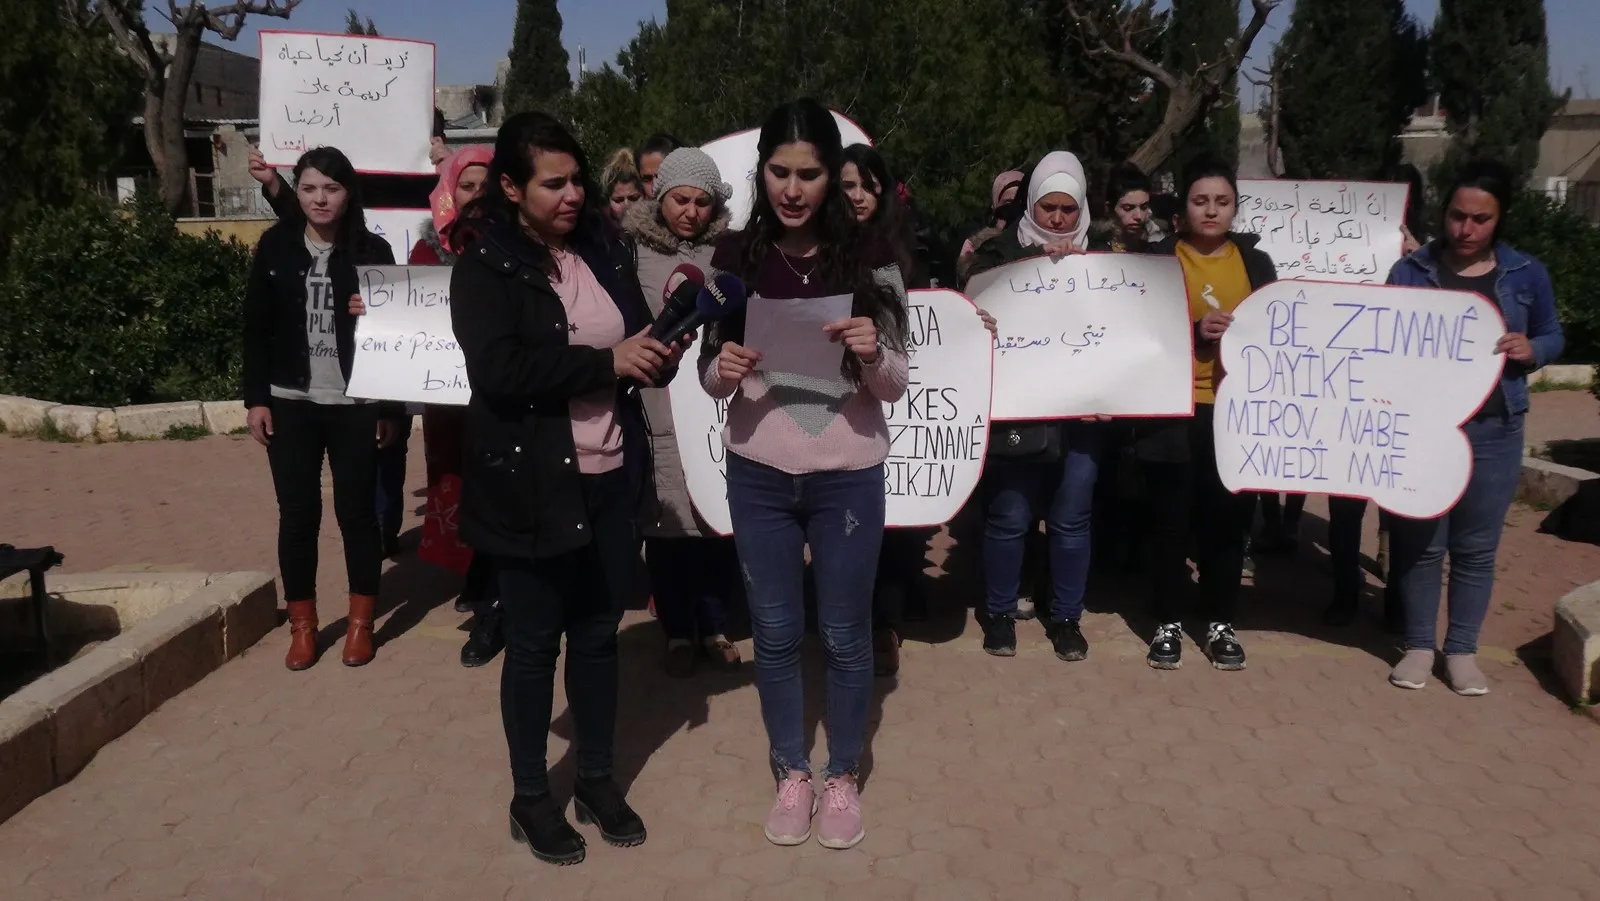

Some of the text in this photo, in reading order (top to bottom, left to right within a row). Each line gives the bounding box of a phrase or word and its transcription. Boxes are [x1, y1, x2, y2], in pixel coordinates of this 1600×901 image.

[278, 37, 409, 71] نريد أن نحيا حياة
[296, 76, 398, 101] كريمة على
[284, 102, 341, 128] أرضنا
[1270, 215, 1285, 244] لم
[1326, 219, 1370, 247] الفكر
[363, 268, 395, 308] Bi
[1009, 267, 1059, 294] قلمنا
[1065, 277, 1076, 293] و
[1266, 289, 1478, 362] BÊ ZIMANÊ
[361, 337, 387, 352] em
[906, 387, 958, 421] KES
[887, 414, 985, 461] ZIMANÊ
[1227, 397, 1410, 450] MIROV NABE
[1239, 439, 1329, 481] XWEDÎ
[884, 462, 955, 497] BIKIN
